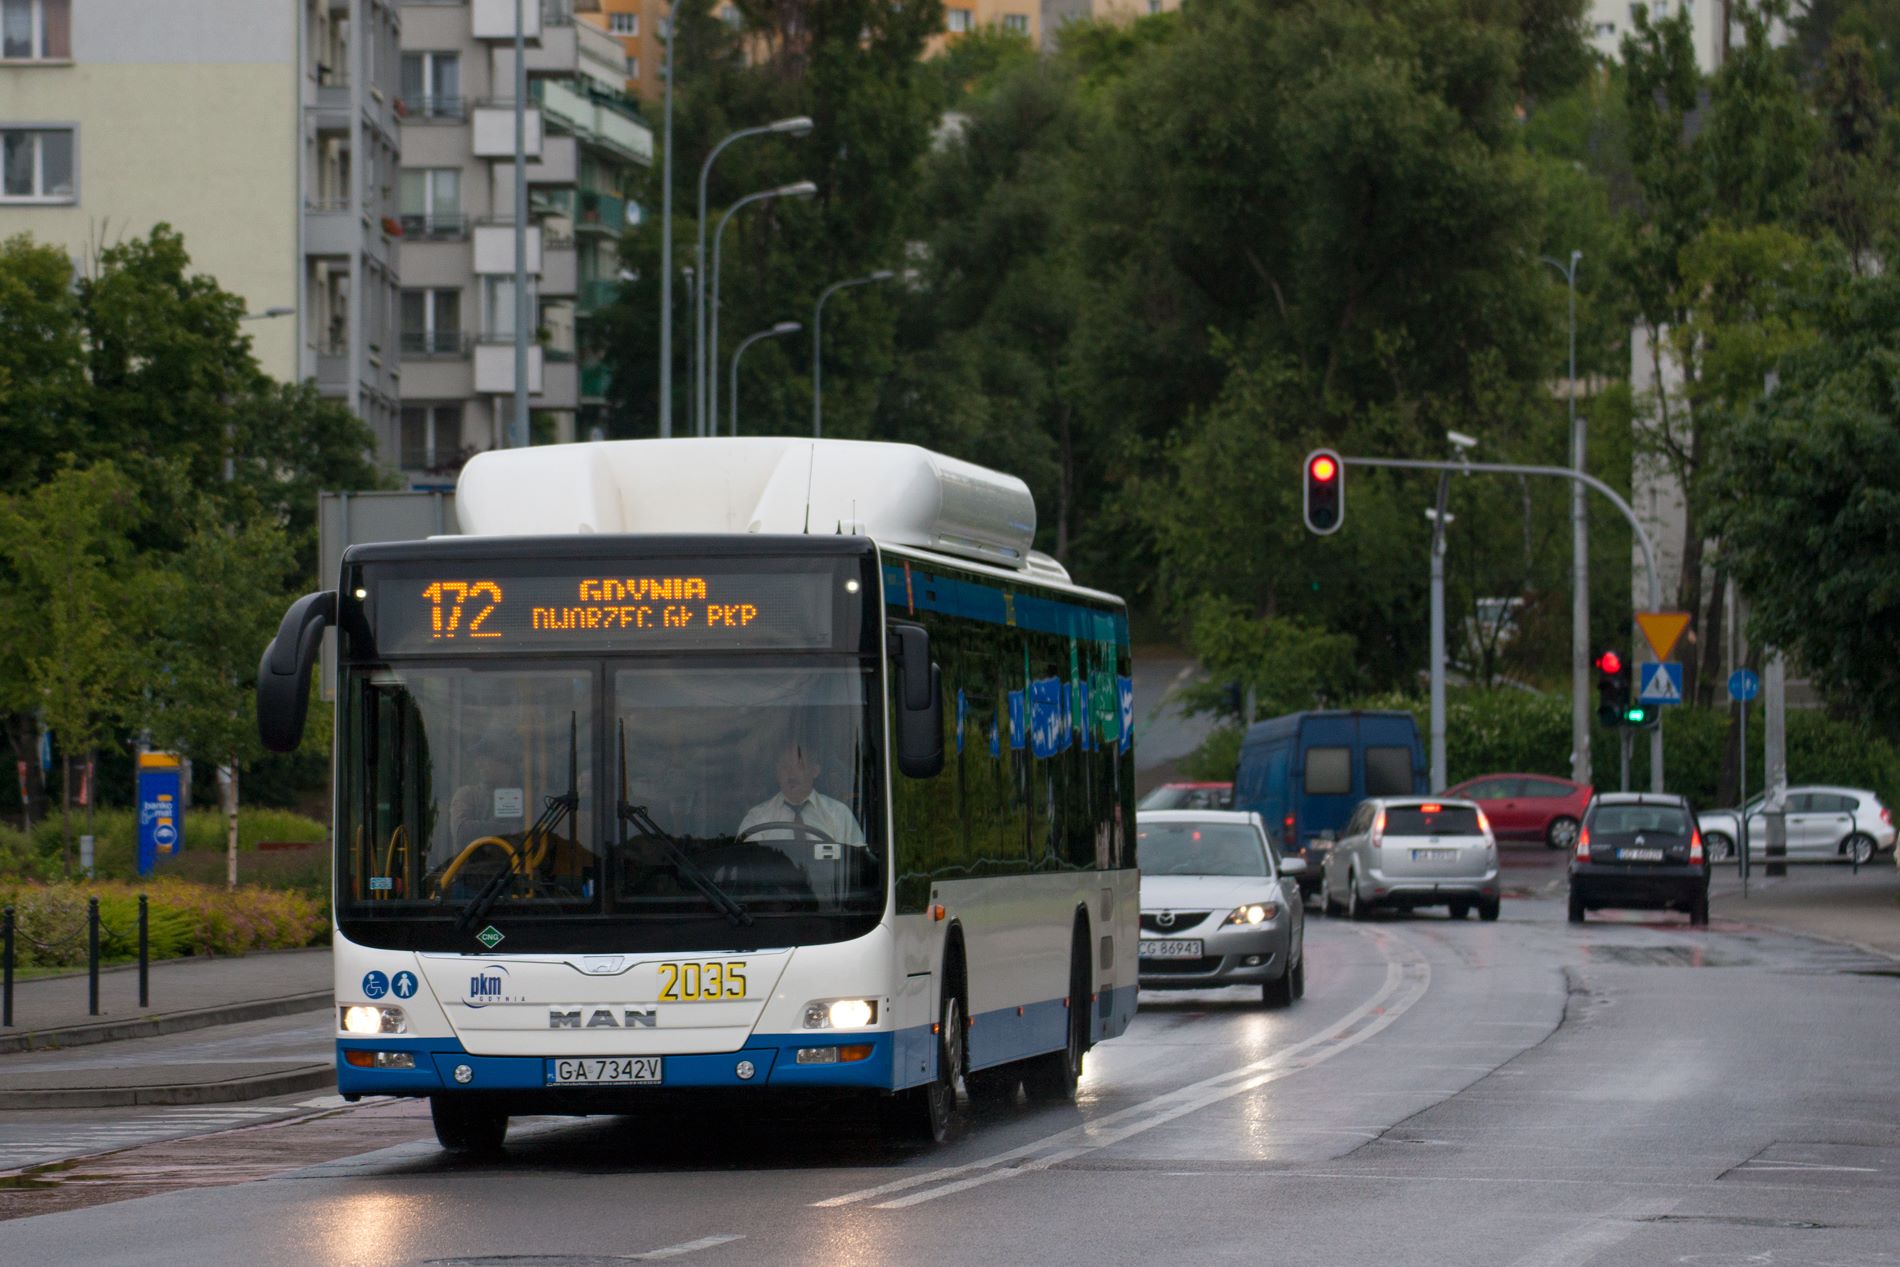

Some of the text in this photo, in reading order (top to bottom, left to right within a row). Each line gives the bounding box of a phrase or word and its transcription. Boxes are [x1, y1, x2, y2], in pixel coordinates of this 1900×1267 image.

[580, 577, 707, 601] GDYNIA
[422, 581, 502, 638] 172
[706, 603, 758, 627] PKP
[481, 932, 499, 942] CNG
[1160, 942, 1200, 954] 86943
[470, 972, 502, 998] pkm
[657, 961, 747, 1002] 2035
[549, 1006, 657, 1029] MAN
[559, 1059, 659, 1080] GA 7342V
